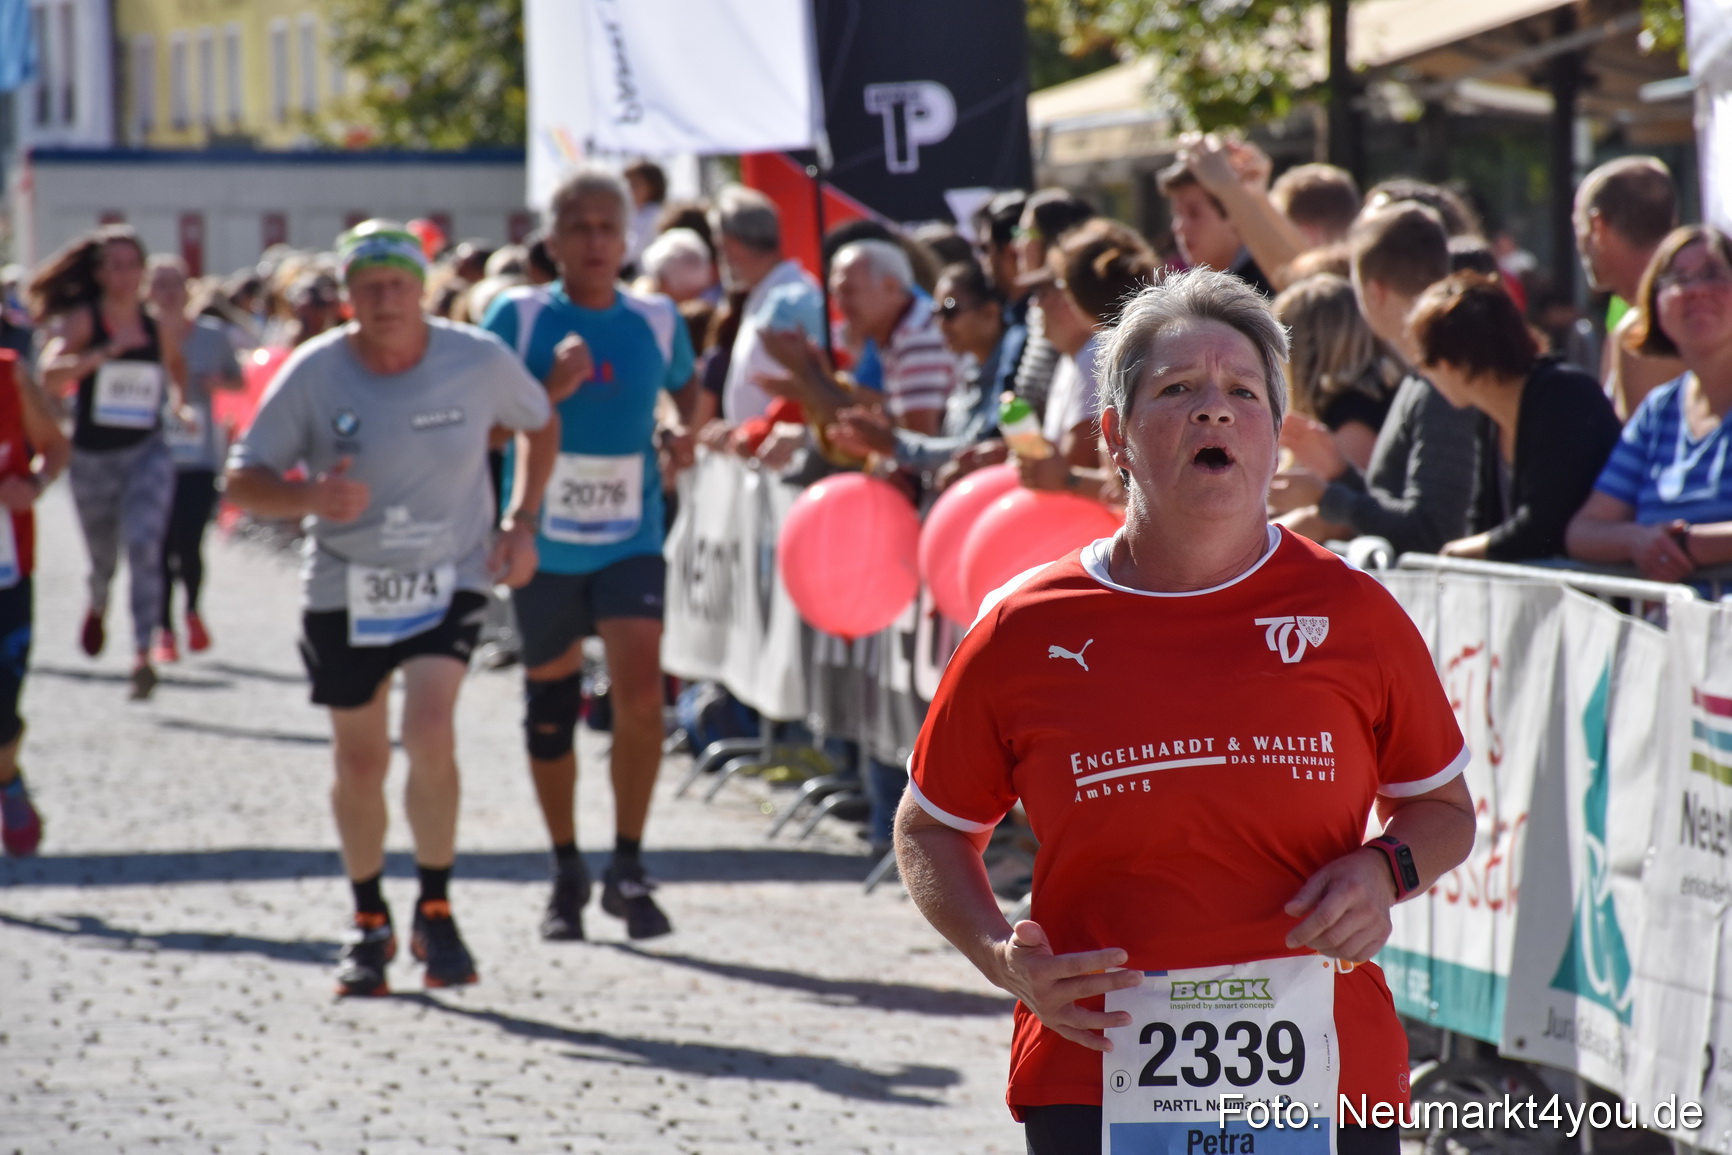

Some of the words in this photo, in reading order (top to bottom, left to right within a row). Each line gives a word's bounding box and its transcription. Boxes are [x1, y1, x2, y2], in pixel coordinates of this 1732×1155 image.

[561, 479, 627, 508] 2076
[365, 568, 438, 604] 3074
[1070, 737, 1215, 775] ENGELHARDT
[1228, 737, 1240, 751] &
[1253, 731, 1334, 753] WALTER
[1231, 755, 1255, 764] DAS
[1262, 755, 1335, 767] HERRENHAUS
[1293, 767, 1335, 781] Lauf
[1074, 779, 1151, 803] Amberg
[1170, 978, 1273, 1001] BOCK
[1138, 1020, 1306, 1087] 2339
[1117, 1076, 1124, 1087] D
[1153, 1099, 1203, 1112] PARTL
[1206, 1098, 1271, 1111] Neumakt
[1187, 1129, 1255, 1155] Petra
